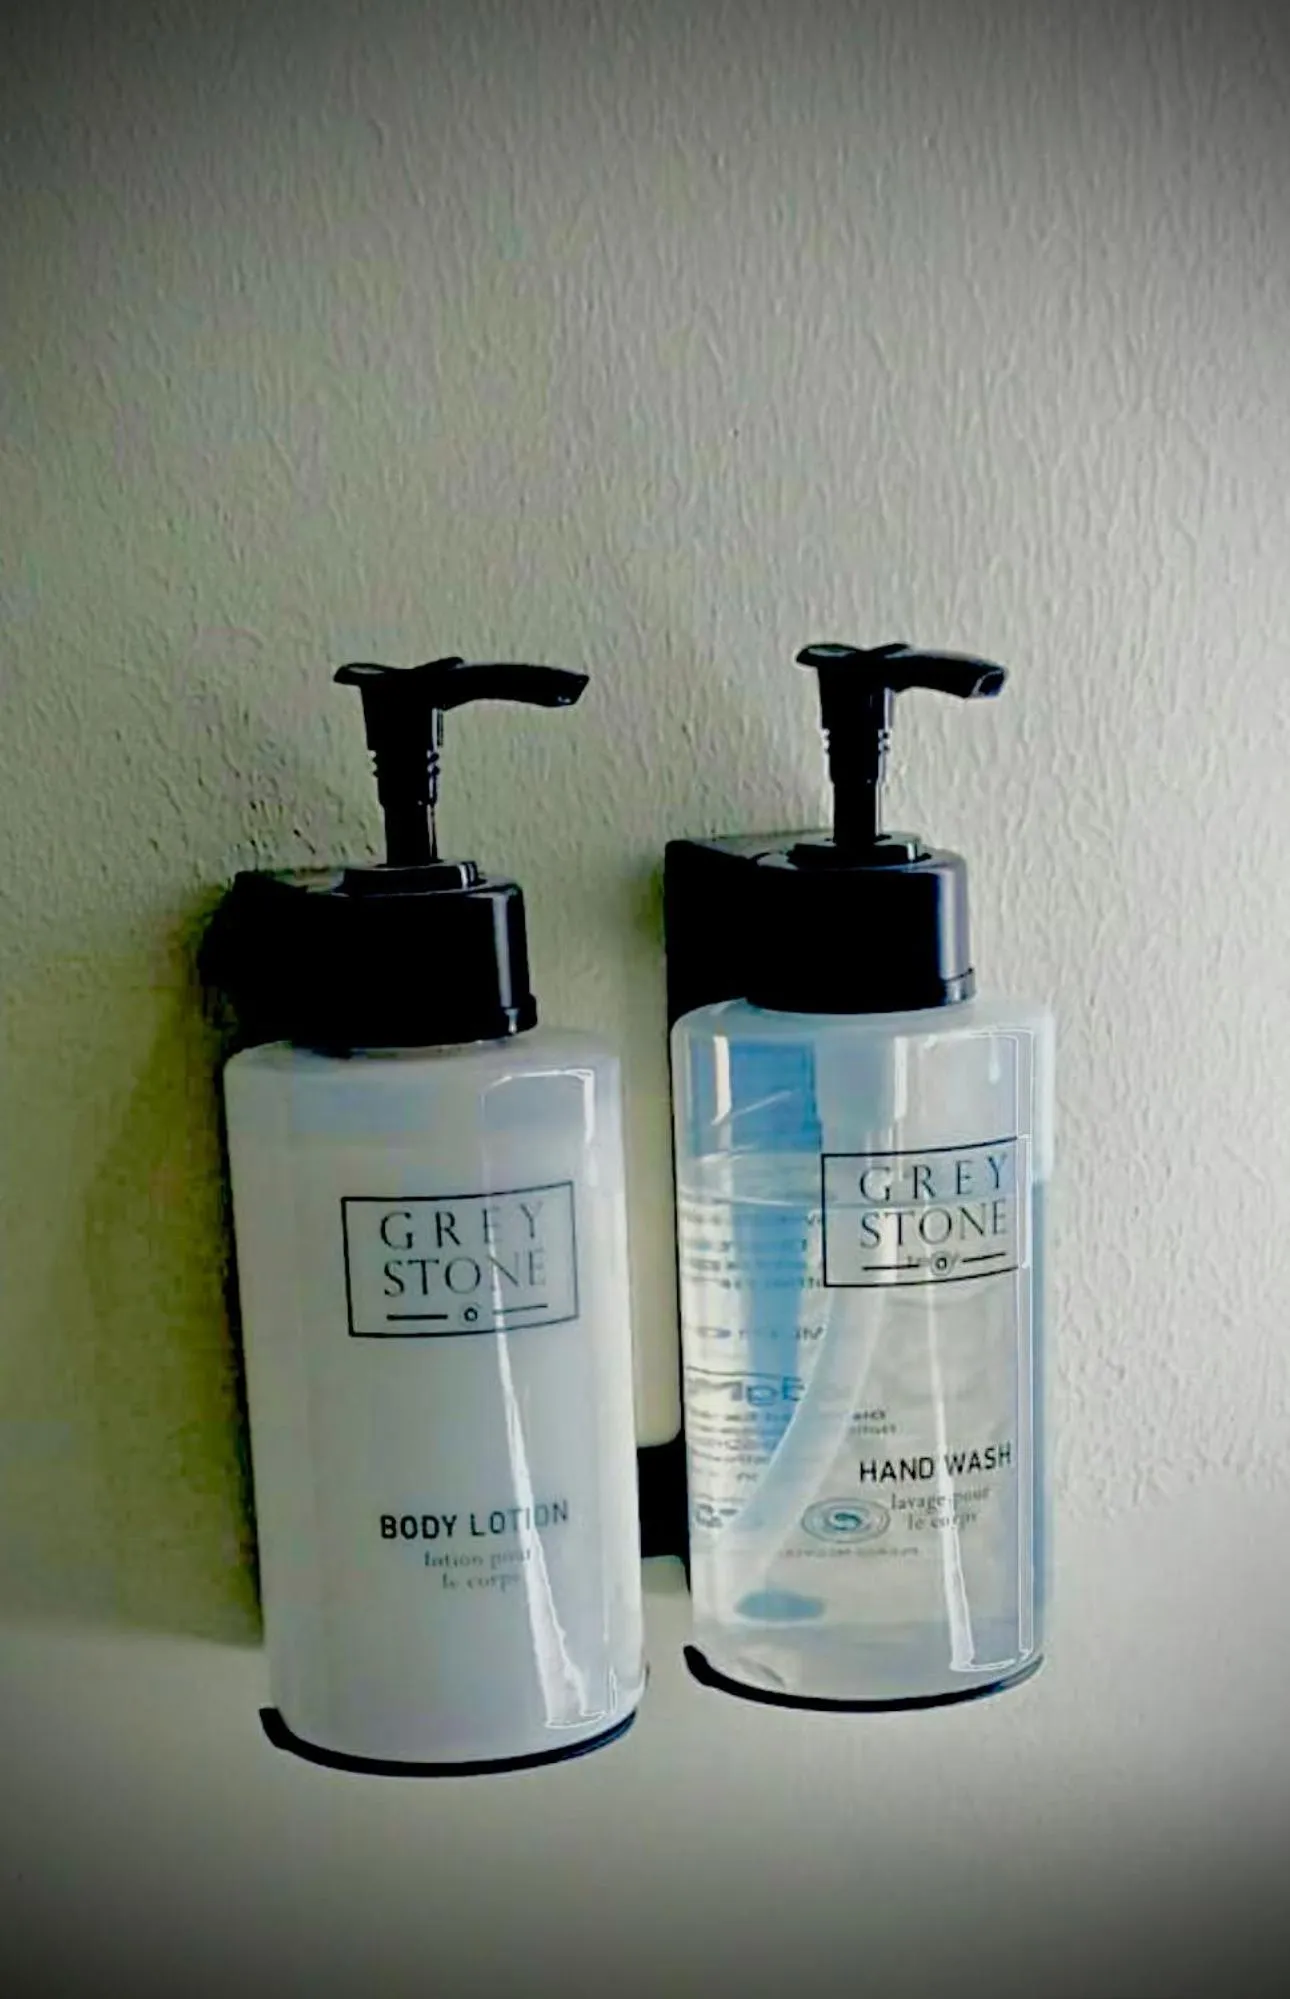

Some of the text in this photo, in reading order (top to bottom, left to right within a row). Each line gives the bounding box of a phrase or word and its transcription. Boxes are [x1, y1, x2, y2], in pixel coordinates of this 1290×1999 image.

[859, 1152, 1008, 1201] GREY
[860, 1200, 1008, 1249] STONE
[383, 1250, 547, 1297] STONE
[859, 1441, 1012, 1483] HAND WASH
[380, 1500, 569, 1540] BODY LOTION
[891, 1492, 946, 1514] lavage
[424, 1550, 484, 1567] lotion
[442, 1573, 459, 1589] le
